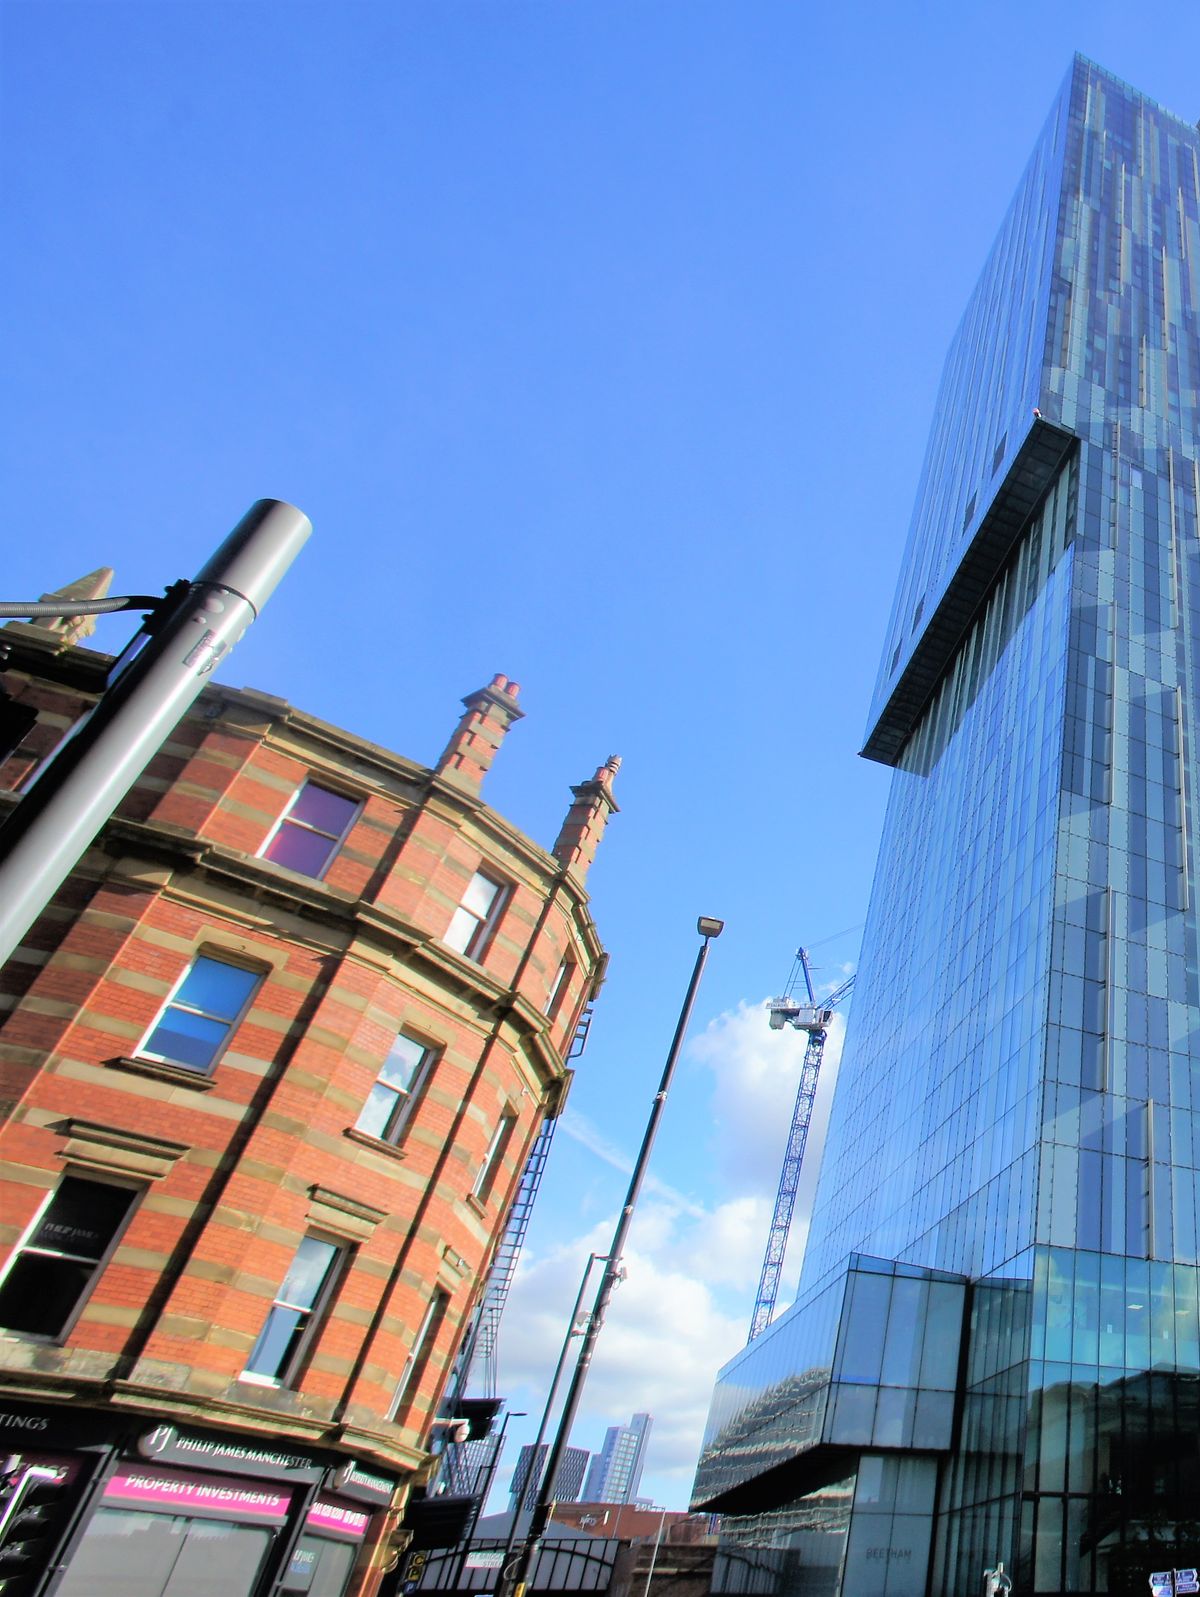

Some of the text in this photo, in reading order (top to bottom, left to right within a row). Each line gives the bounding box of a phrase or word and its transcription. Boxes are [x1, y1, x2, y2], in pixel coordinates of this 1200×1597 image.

[176, 1436, 313, 1469] PHILIP JAMES MANCHESTER
[125, 1474, 281, 1507] PROPERTY INVESTMENTS
